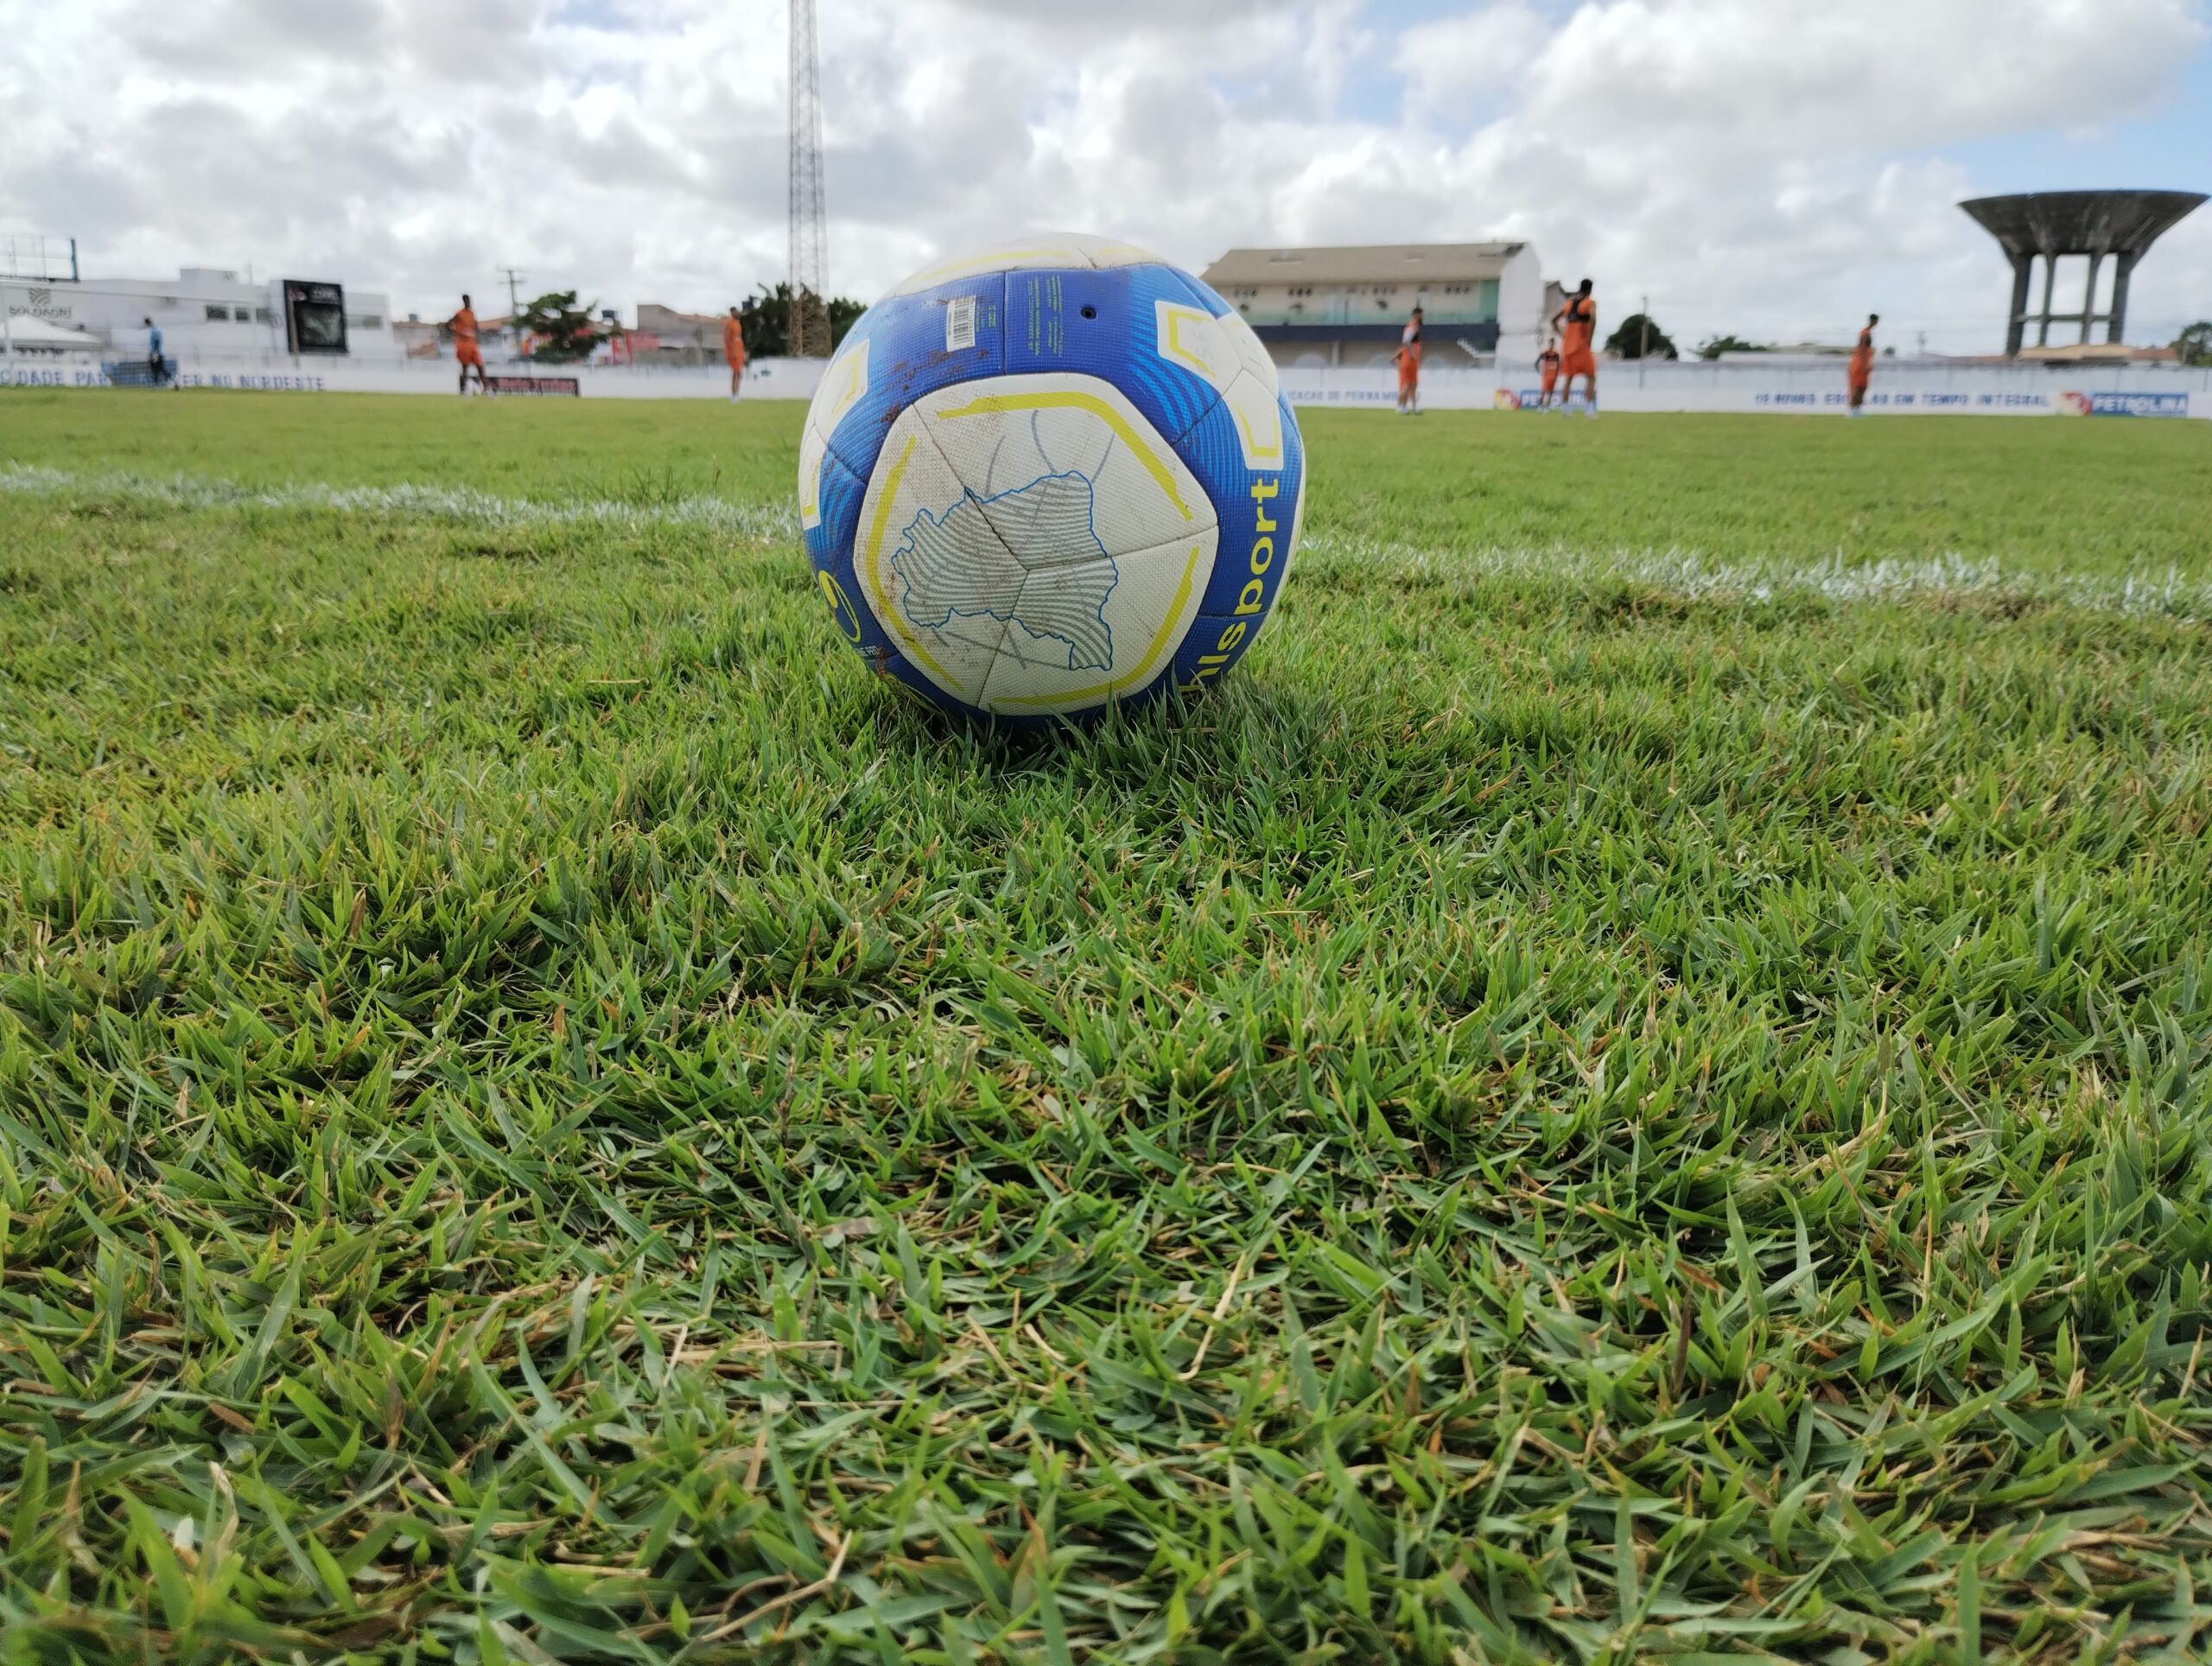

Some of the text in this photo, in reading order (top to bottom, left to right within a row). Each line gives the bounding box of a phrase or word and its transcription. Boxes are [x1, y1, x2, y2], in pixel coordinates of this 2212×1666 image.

[0, 369, 62, 386] CDADE
[74, 371, 109, 386] PAR
[239, 374, 324, 391] NORDESTE
[2092, 396, 2187, 415] PETROLINA
[1179, 479, 1279, 692] hlsport
